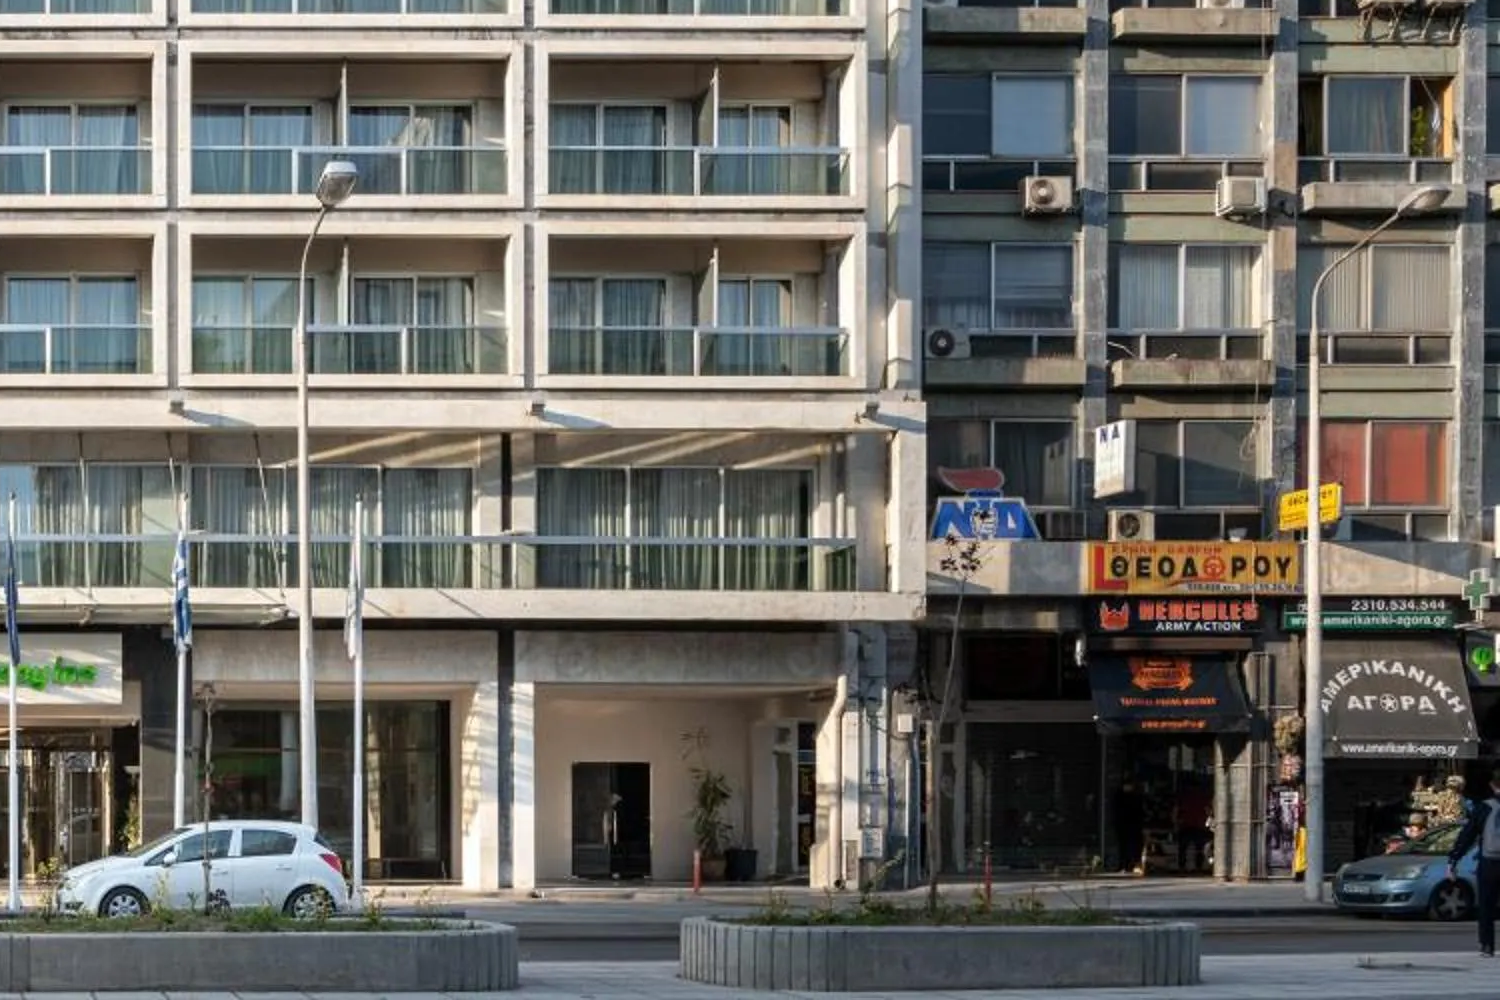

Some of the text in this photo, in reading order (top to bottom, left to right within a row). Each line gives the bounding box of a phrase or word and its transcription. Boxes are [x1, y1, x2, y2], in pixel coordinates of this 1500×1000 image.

[1138, 600, 1259, 621] HERCULES
[1351, 600, 1446, 611] 2310.534.544
[1155, 621, 1242, 631] ARMY ACTION
[1320, 658, 1467, 714] ΑΜΕΡΙΚΑΝΙΚΗ
